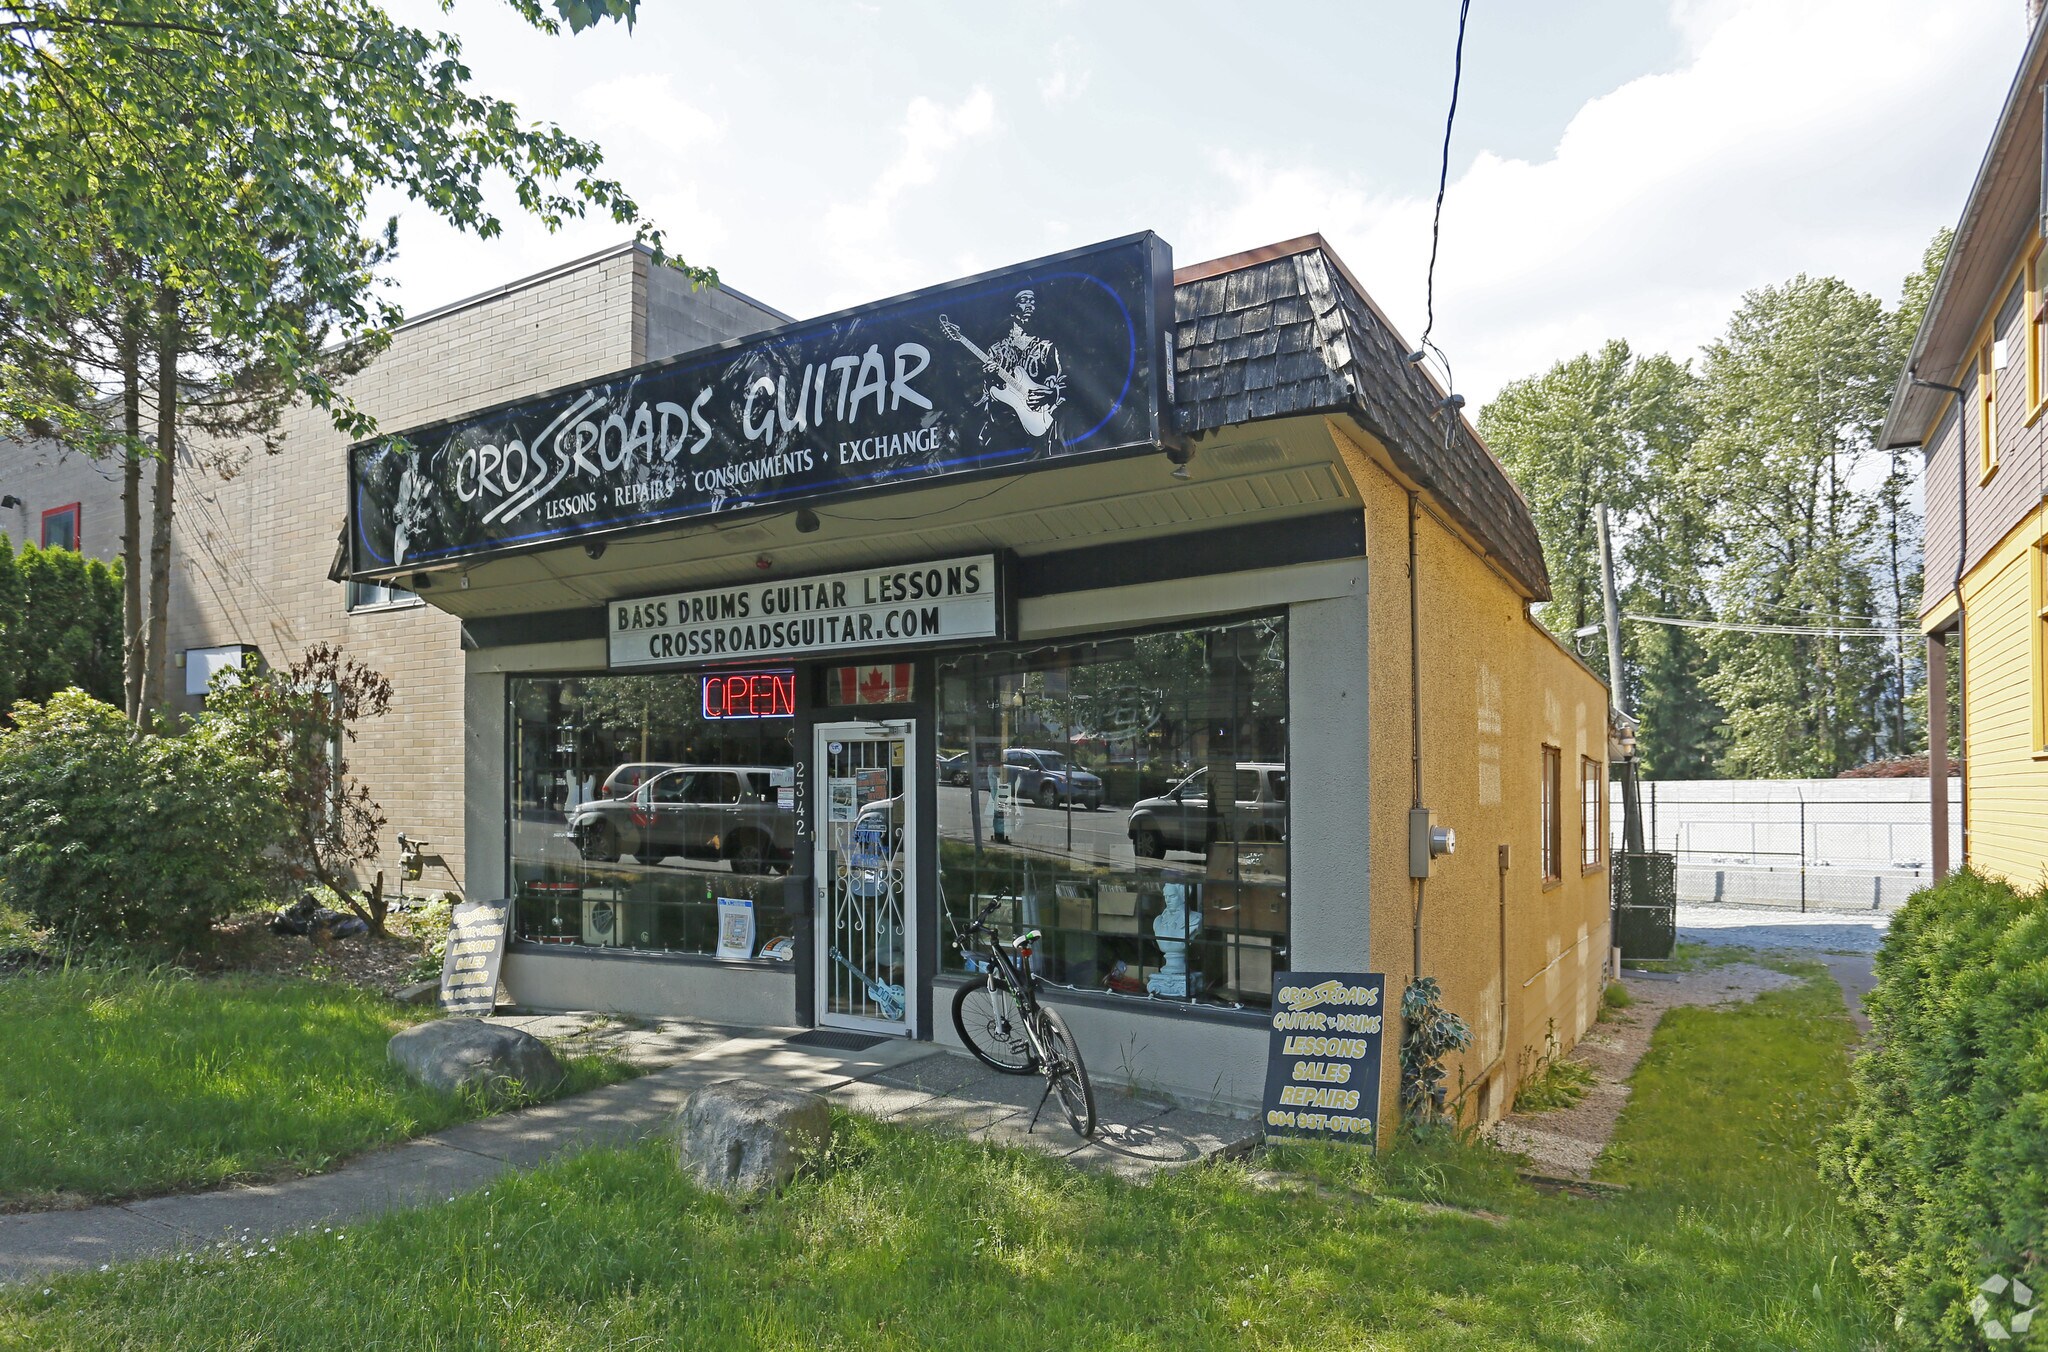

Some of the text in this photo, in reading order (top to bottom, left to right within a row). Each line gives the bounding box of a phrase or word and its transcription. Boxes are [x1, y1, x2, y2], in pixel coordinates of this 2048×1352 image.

[457, 342, 933, 525] CROSSROADS GUITAR
[545, 426, 940, 520] LESSONS REPAIRS CONSIGNMENTS EXCHANGE
[617, 564, 980, 631] BASS DRUMS GUITAR LESSONS
[648, 606, 941, 658] CROSSROADSGUITAR.COM
[704, 674, 795, 717] OPEN
[452, 939, 496, 956] LESSONS
[456, 957, 486, 970] SALES
[1278, 980, 1379, 1011] CROSSROADS
[1273, 1011, 1326, 1032] GUITAR
[1336, 1013, 1382, 1034] DRUMS
[1282, 1035, 1367, 1059] LESSONS
[1292, 1061, 1352, 1083] SALES
[1279, 1086, 1360, 1110] REPAIRS
[1267, 1110, 1296, 1127] 604
